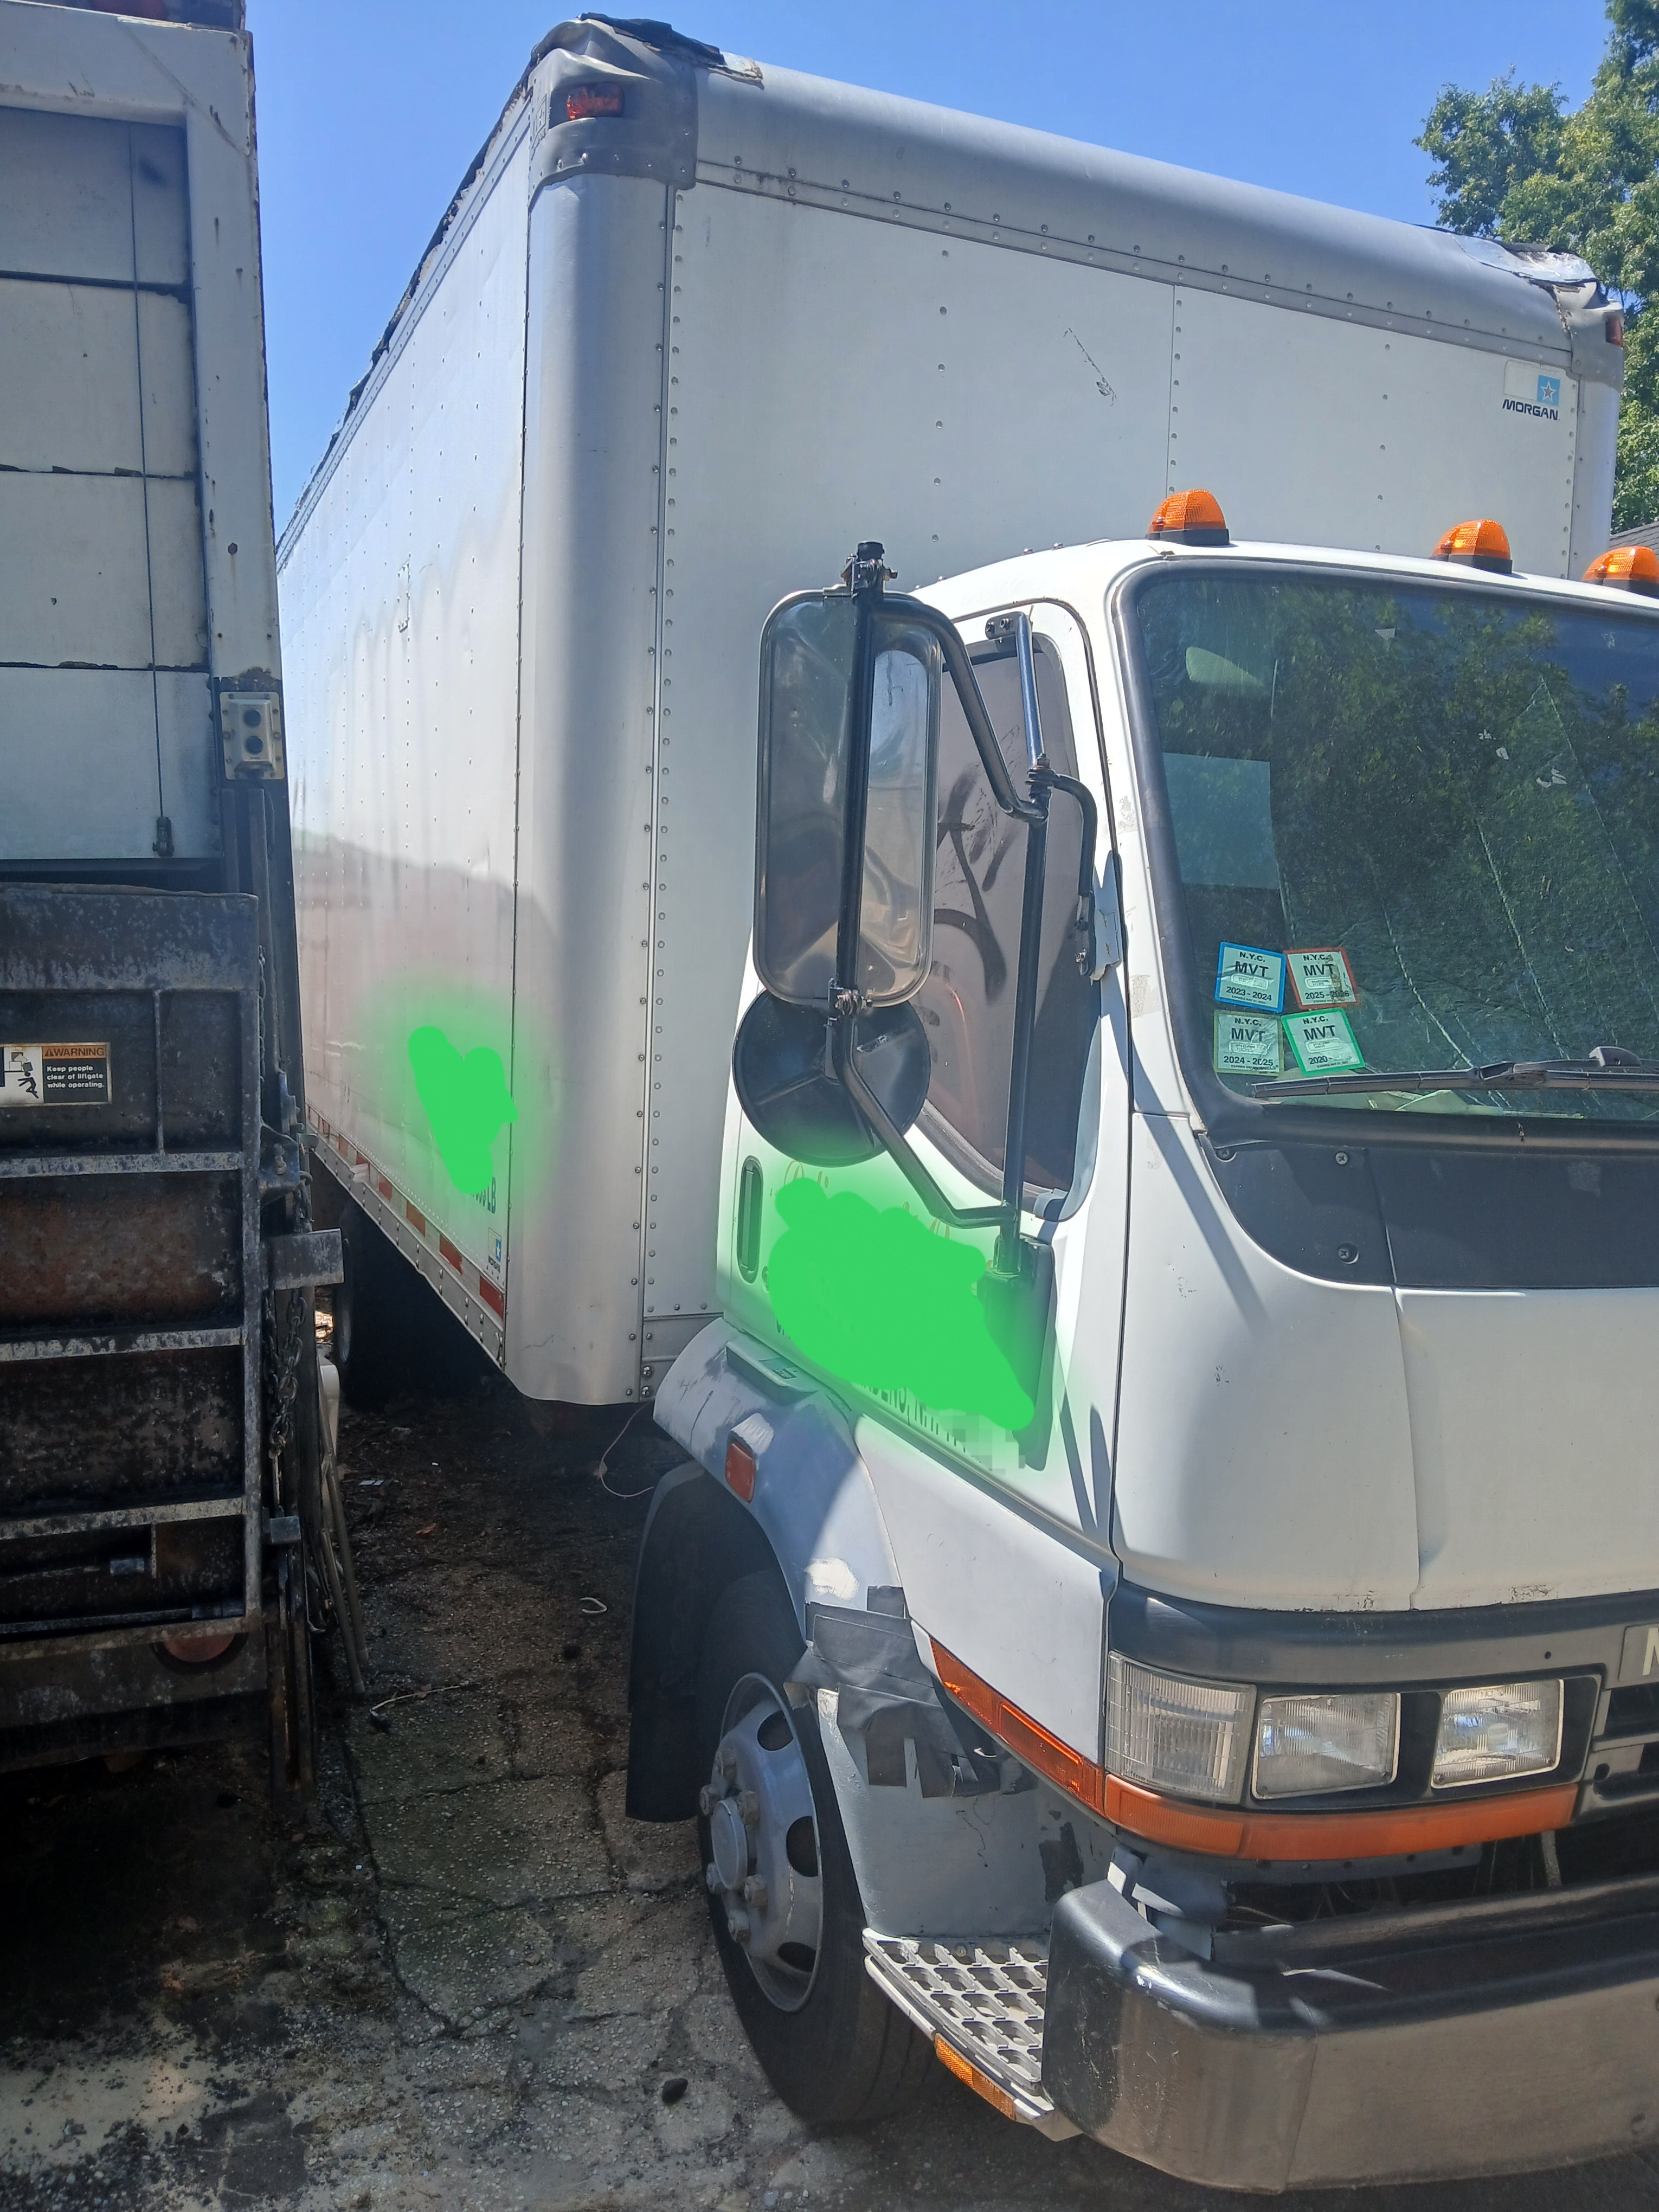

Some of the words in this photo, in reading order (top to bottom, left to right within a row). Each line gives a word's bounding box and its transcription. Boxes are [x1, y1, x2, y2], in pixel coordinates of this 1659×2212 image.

[1502, 398, 1558, 421] MORGAN
[1239, 951, 1265, 962] N.Y.C.
[1235, 961, 1269, 977] MVT
[1303, 963, 1334, 976] MVT
[1234, 1017, 1261, 1026] N.Y.C.
[1303, 1016, 1328, 1024] N.Y.C.
[1231, 1027, 1265, 1041] MVT
[1303, 1025, 1335, 1040] MVT
[54, 1047, 104, 1056] WARNING
[1308, 1056, 1328, 1064] 2020
